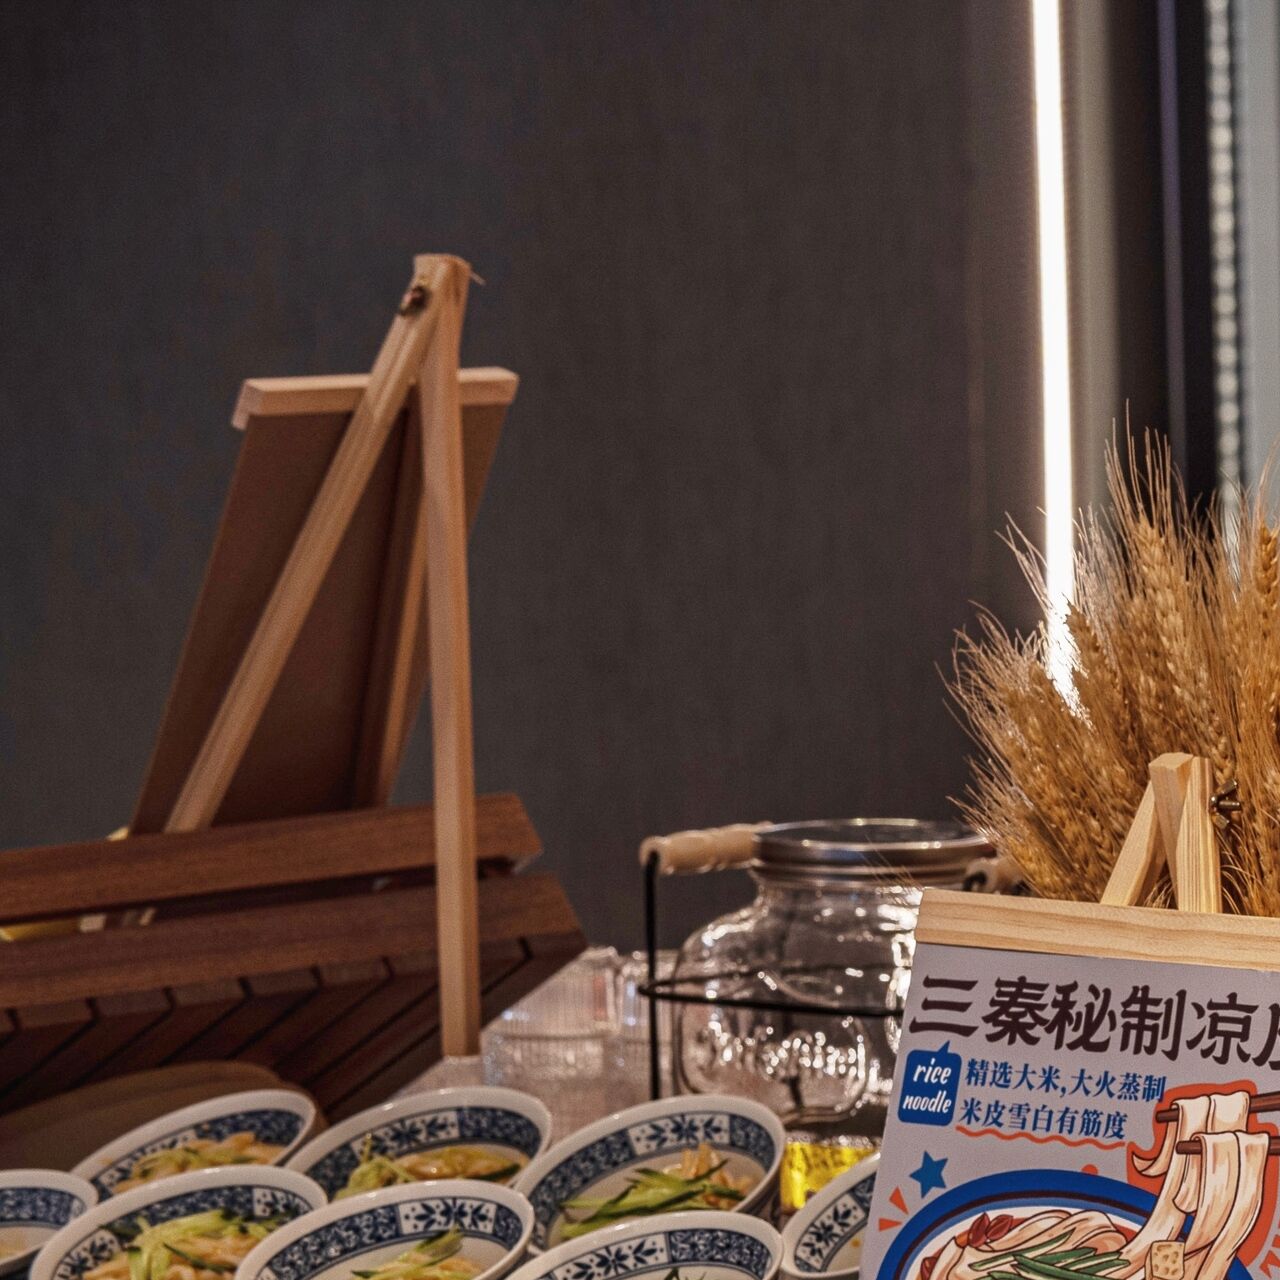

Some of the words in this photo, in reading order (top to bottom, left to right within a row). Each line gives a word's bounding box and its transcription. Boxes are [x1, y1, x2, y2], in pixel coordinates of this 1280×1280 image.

[913, 1057, 952, 1085] rice
[902, 1090, 952, 1114] noodle
[959, 1097, 1129, 1140] 米皮雪白有筋度
